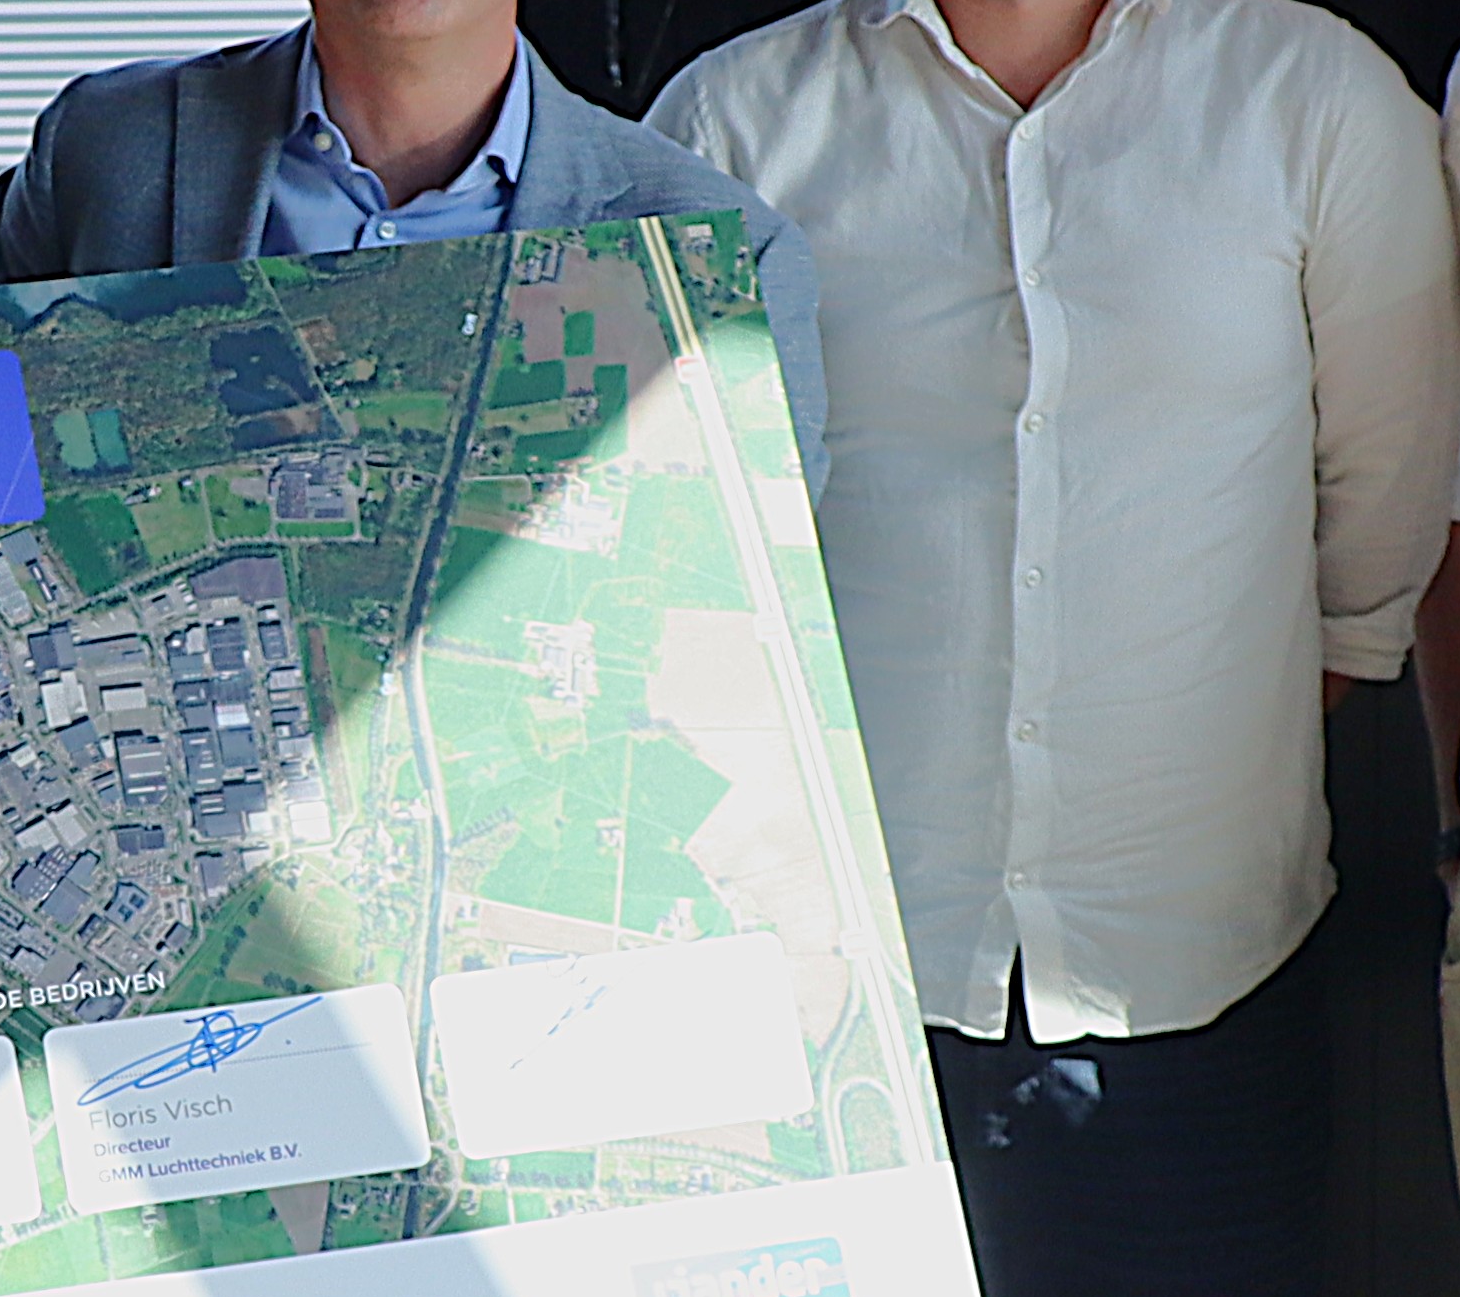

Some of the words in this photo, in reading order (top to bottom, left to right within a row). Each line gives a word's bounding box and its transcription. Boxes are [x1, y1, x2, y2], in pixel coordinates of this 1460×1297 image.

[30, 970, 166, 1005] BEDRIJVEN
[90, 1105, 157, 1132] Floris
[165, 1093, 233, 1122] Visch
[95, 1134, 171, 1158] Directeur
[99, 1164, 145, 1185] GMM
[148, 1148, 266, 1179] Luchttechniek
[271, 1142, 302, 1161] B.V.
